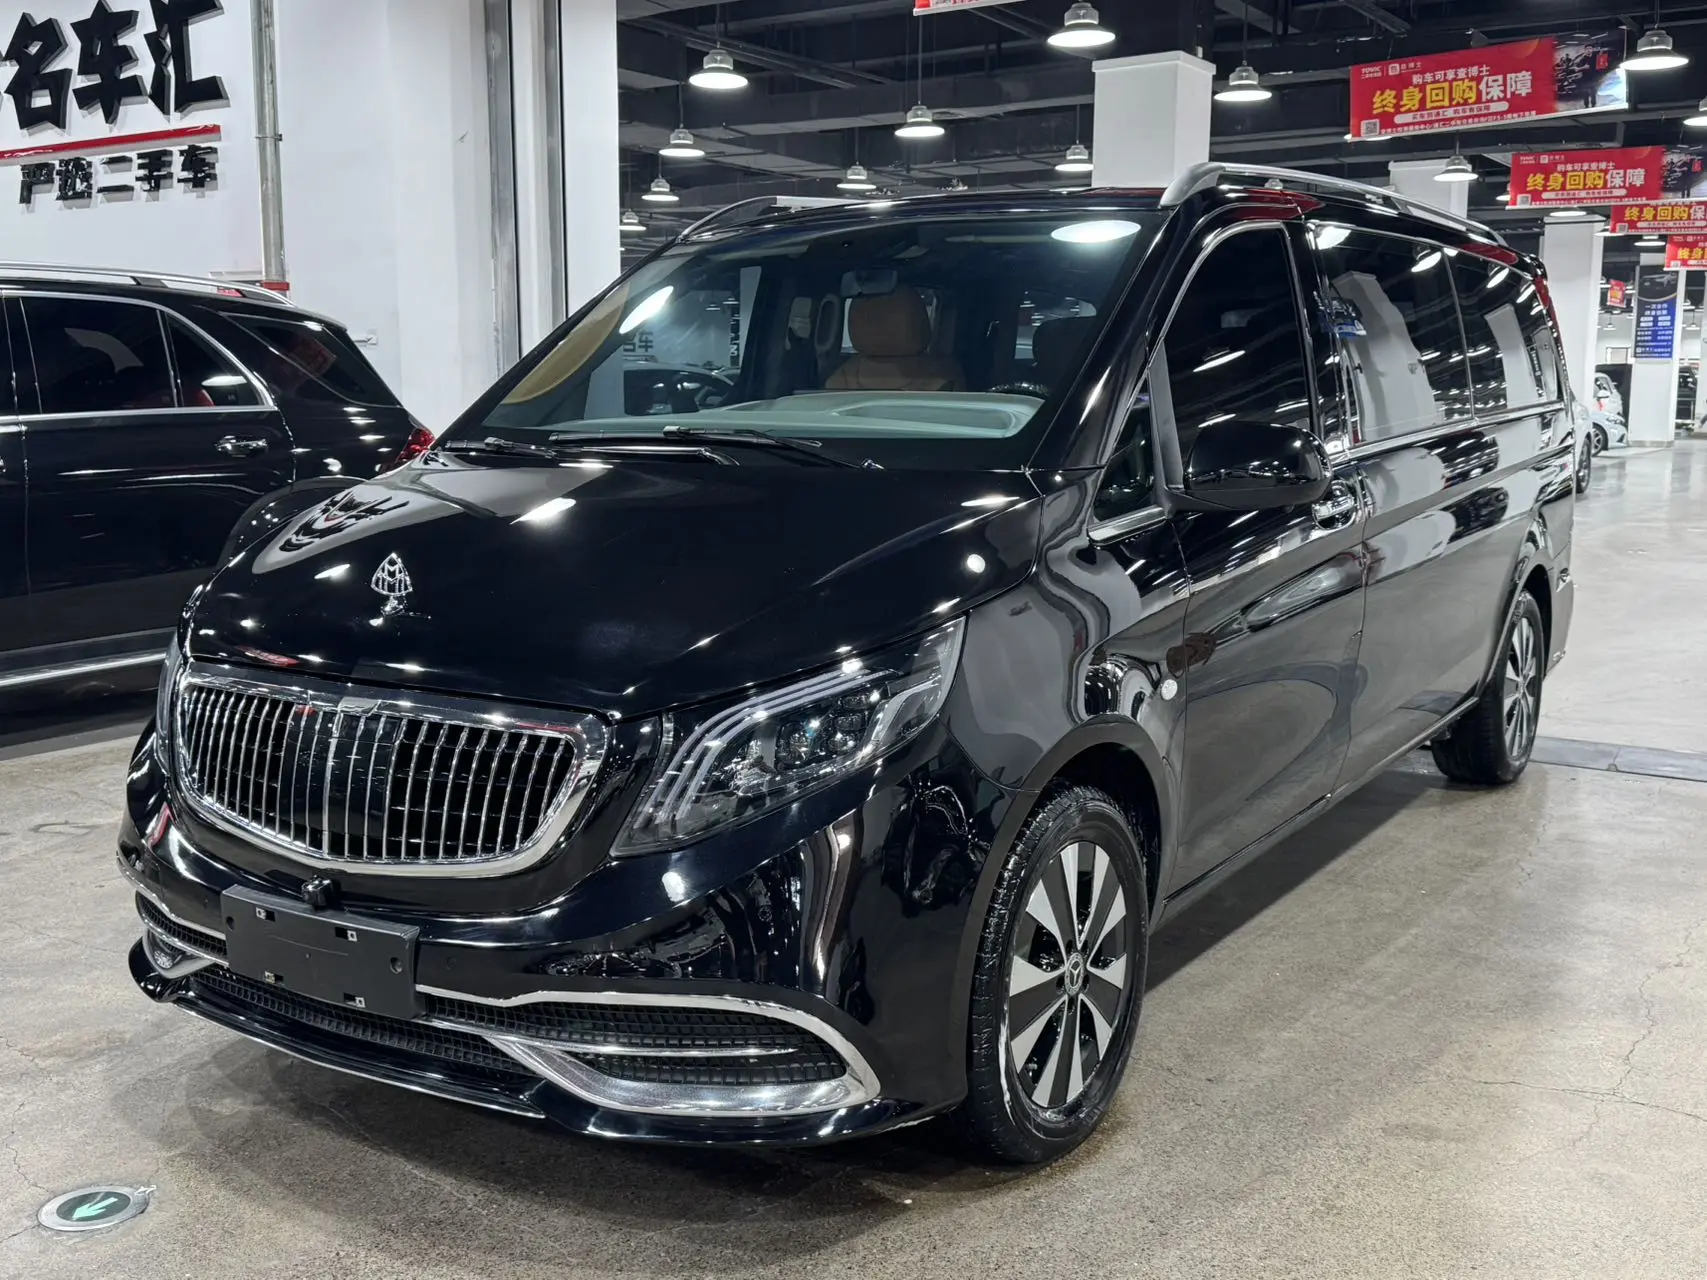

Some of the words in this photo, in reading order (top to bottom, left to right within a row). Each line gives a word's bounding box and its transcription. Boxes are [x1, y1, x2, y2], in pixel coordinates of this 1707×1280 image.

[1, 0, 231, 134] 名车汇
[1412, 65, 1490, 85] 购车可享查博士
[1372, 71, 1533, 114] 终身回购保障
[1526, 168, 1646, 191] 终身回购保障
[1624, 205, 1707, 221] 终身回购保
[1677, 247, 1707, 260] 终身
